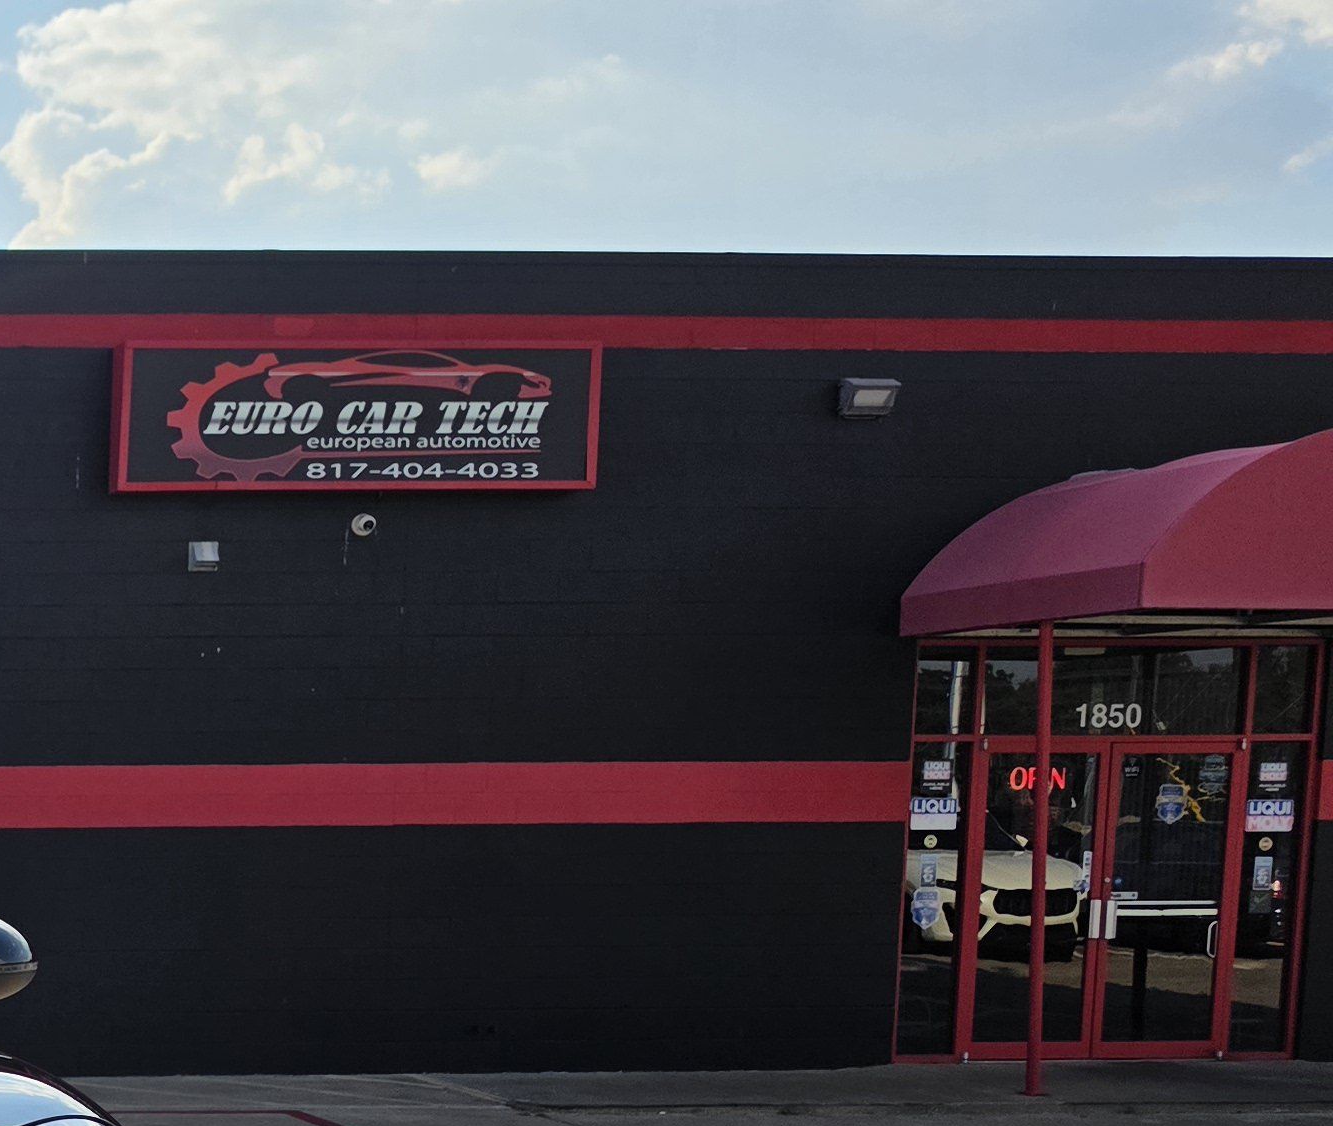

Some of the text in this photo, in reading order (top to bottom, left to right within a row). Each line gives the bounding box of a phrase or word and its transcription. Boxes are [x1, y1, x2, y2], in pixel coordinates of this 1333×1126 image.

[203, 400, 550, 435] EURO CAR TECH
[306, 434, 541, 452] european automotive
[306, 462, 540, 479] 817-404-4033
[1075, 703, 1142, 728] 1850
[1009, 766, 1067, 791] OPN
[913, 799, 957, 814] LIQUI
[1249, 801, 1292, 815] LIQUI
